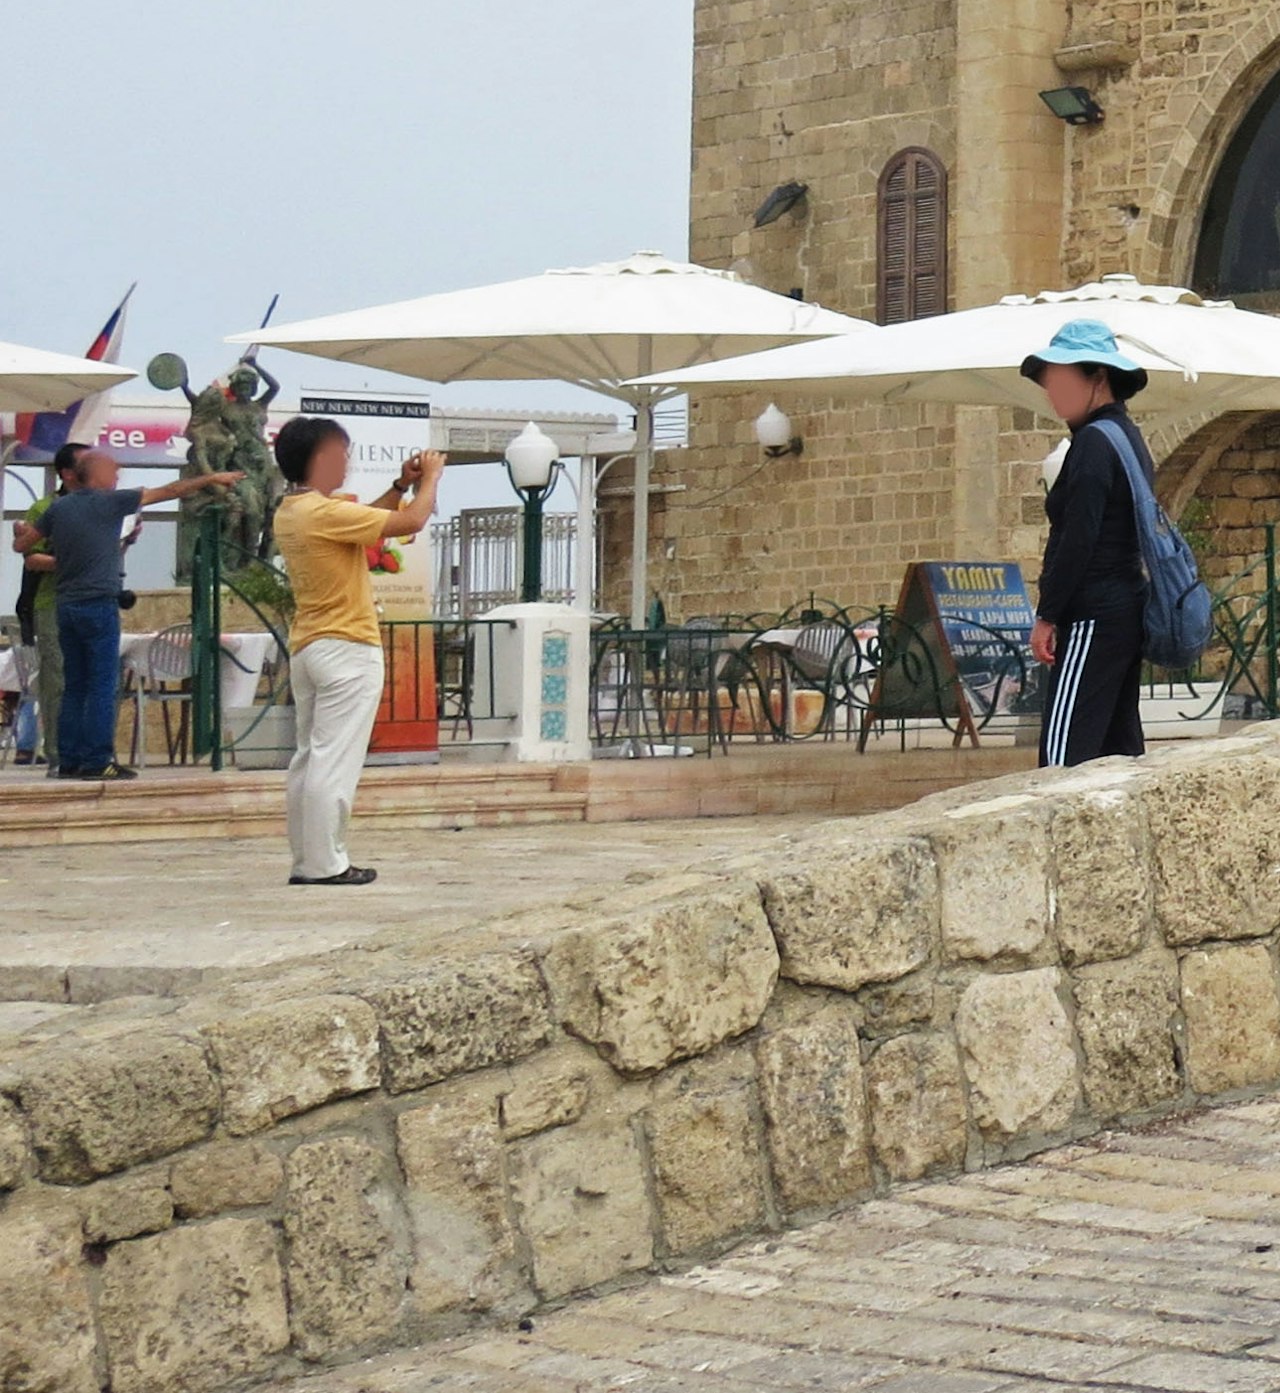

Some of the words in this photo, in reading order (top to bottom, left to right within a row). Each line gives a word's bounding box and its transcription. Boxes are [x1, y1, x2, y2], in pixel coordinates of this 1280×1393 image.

[302, 401, 326, 411] NEW
[328, 402, 353, 412] NEW
[355, 404, 379, 414] NEW
[380, 405, 404, 415] NEW
[405, 406, 429, 416] NEW
[941, 566, 1006, 590] YAMIT
